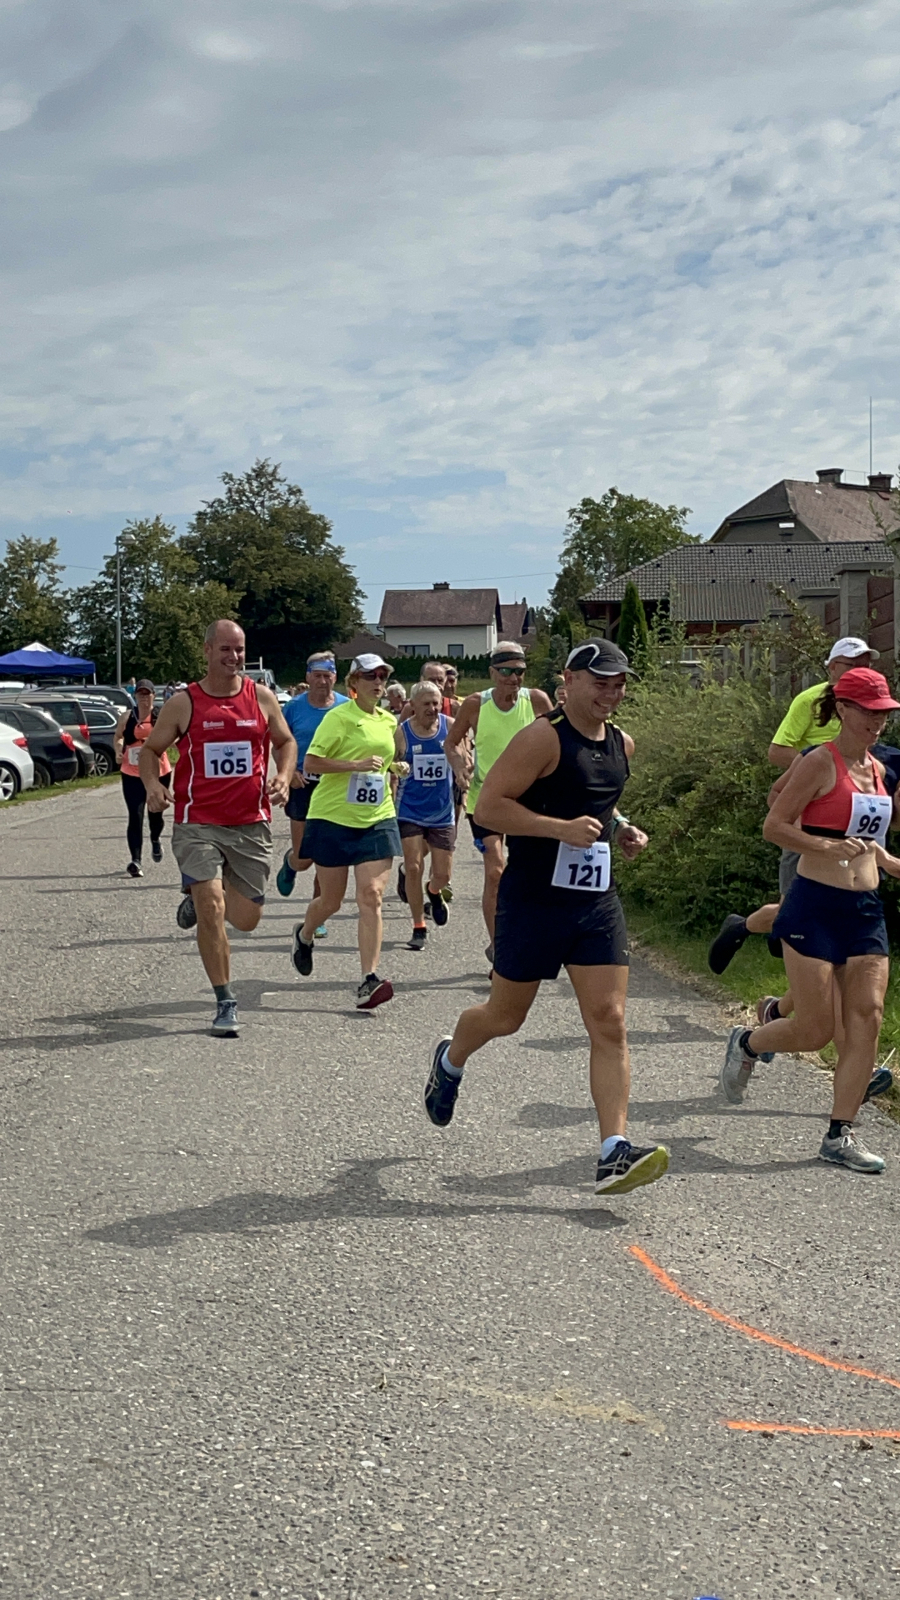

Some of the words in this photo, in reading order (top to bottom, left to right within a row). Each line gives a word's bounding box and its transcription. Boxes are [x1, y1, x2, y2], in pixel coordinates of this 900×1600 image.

[210, 758, 247, 775] 105
[417, 766, 443, 779] 146
[356, 788, 378, 803] 88
[857, 814, 882, 834] 96
[568, 863, 602, 888] 121
